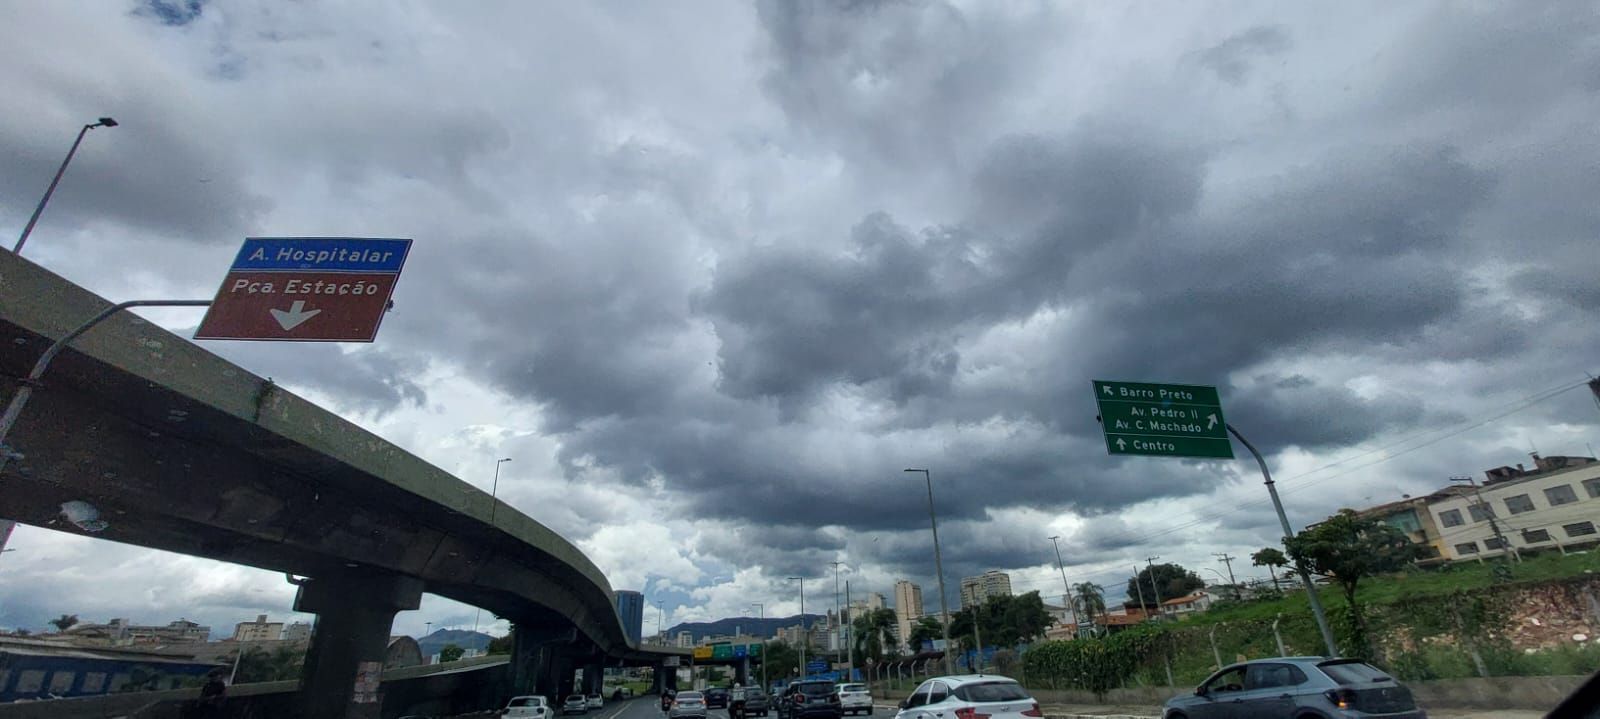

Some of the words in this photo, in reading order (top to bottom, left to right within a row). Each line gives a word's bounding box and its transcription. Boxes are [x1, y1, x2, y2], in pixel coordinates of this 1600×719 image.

[249, 247, 269, 261] A.
[276, 247, 393, 264] Hospitalar
[231, 279, 276, 296] Pça.
[284, 280, 379, 296] Estação
[1120, 387, 1154, 398] Barro
[1159, 389, 1193, 400] Preto
[1131, 407, 1147, 417] Av.
[1151, 407, 1186, 419] Pedro
[1190, 410, 1199, 419] II
[1115, 420, 1132, 430] Av.
[1135, 421, 1147, 431] C.
[1150, 421, 1202, 433] Machado
[1133, 440, 1175, 451] Centro
